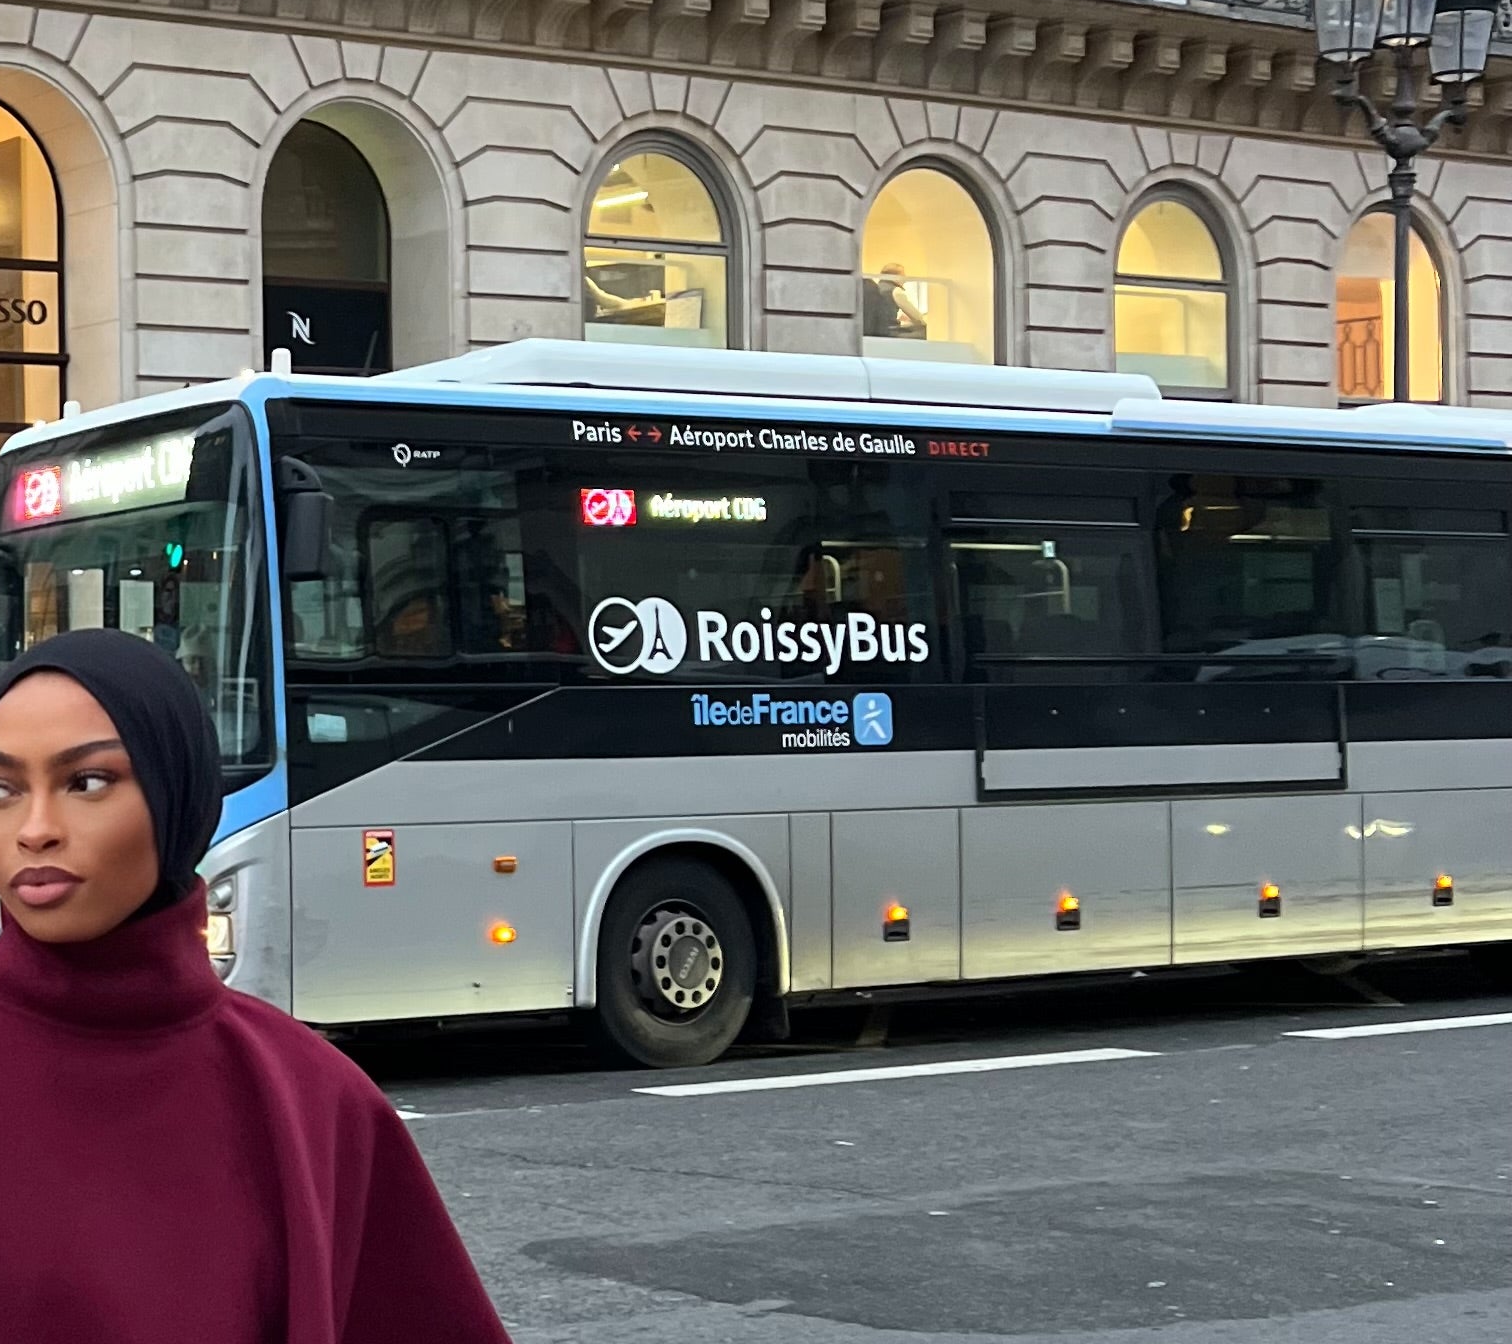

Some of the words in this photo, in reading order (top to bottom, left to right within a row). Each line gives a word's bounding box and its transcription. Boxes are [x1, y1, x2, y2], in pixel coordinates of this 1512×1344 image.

[286, 311, 316, 344] N
[413, 450, 440, 459] RATP
[572, 421, 622, 443] Paris
[670, 425, 754, 451] Aéroport
[759, 429, 828, 451] Charles
[833, 432, 856, 452] de
[859, 433, 916, 455] Gaulle
[928, 441, 989, 457] DIRECT
[649, 493, 732, 523] Aéroport
[733, 497, 767, 521] CDG
[696, 607, 929, 675] RoissyBus
[782, 727, 850, 748] mobilités
